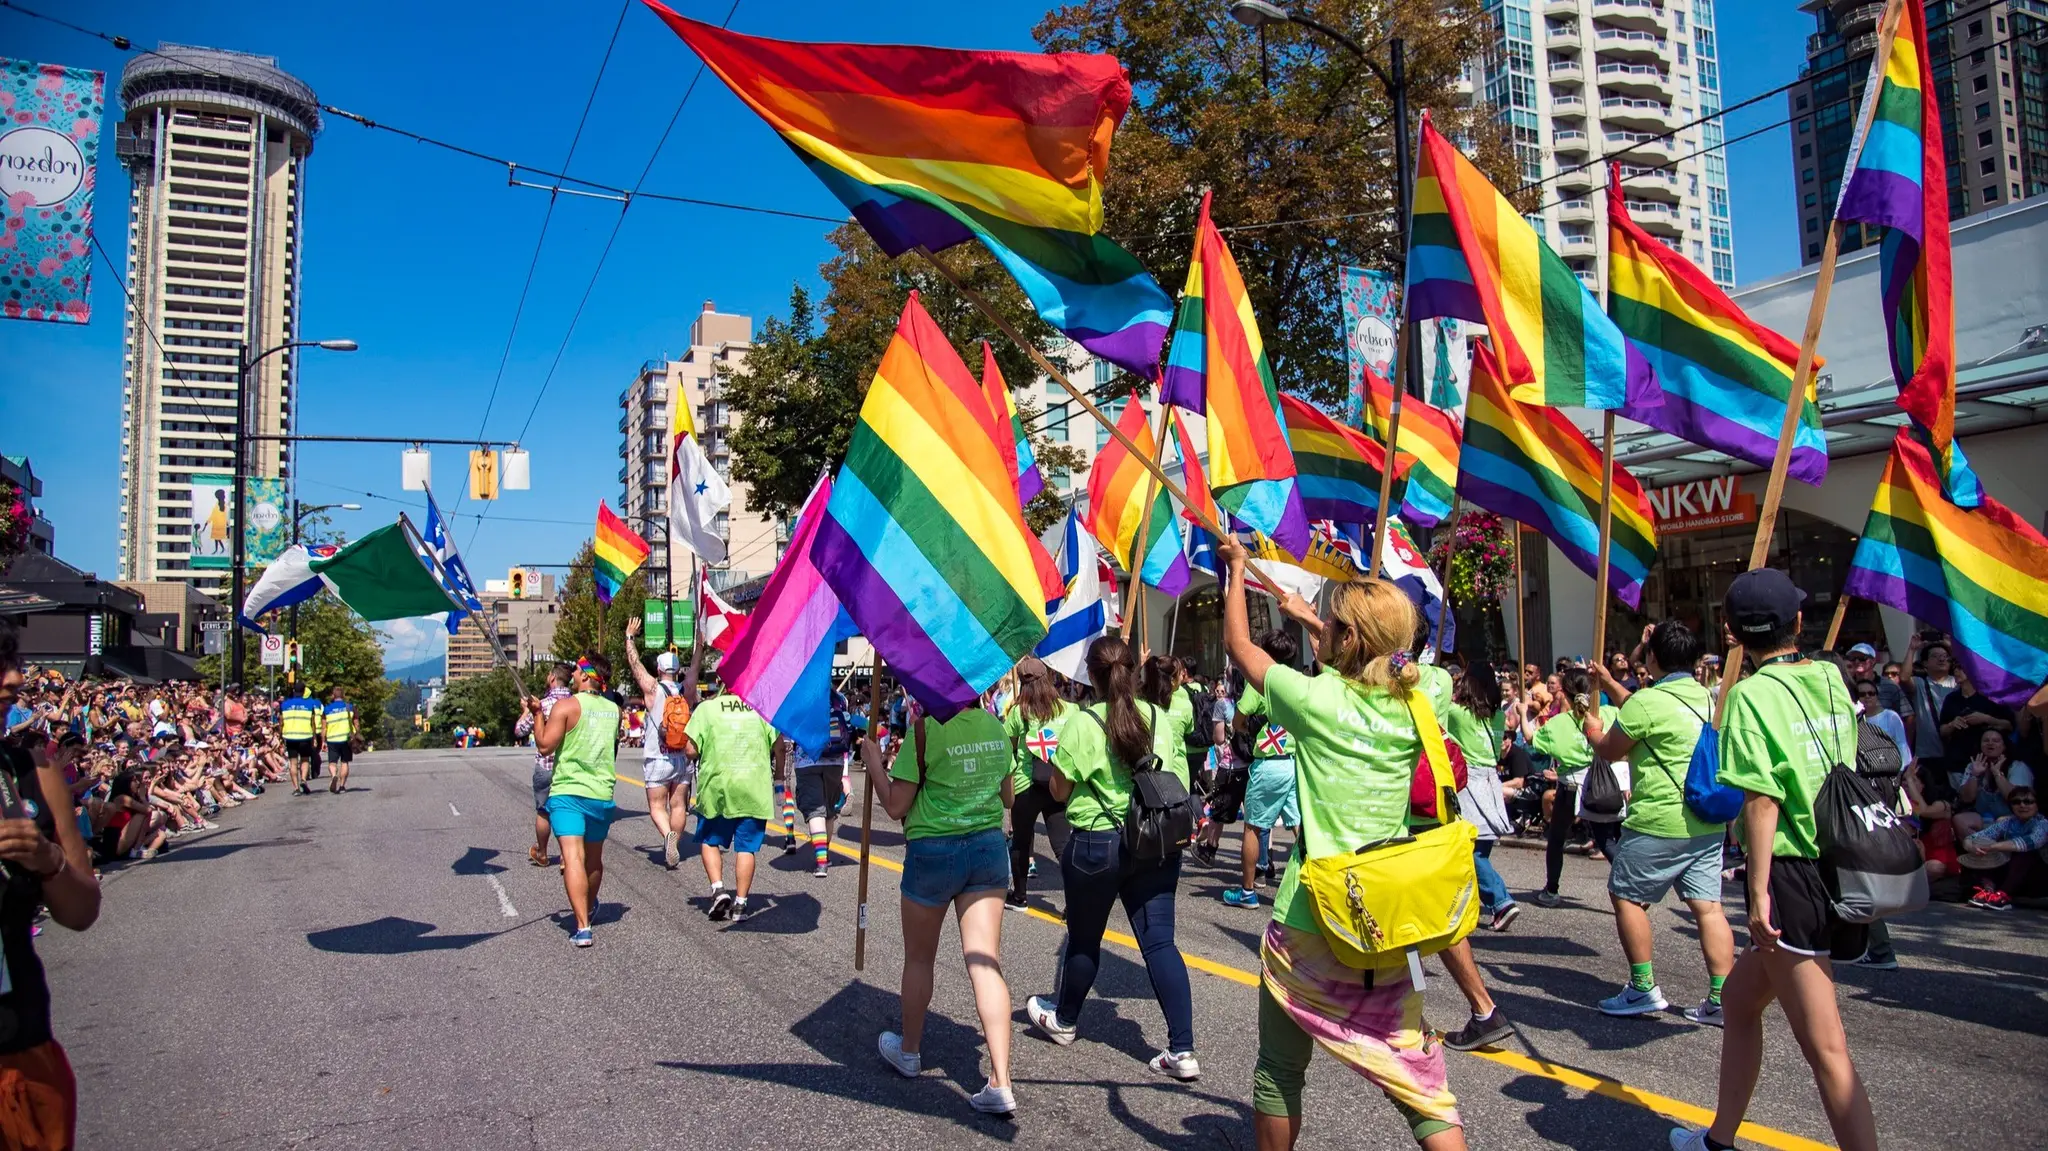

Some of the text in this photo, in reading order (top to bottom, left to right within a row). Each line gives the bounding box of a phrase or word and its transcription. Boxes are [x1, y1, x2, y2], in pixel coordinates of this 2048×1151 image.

[1359, 326, 1394, 349] robson
[1645, 475, 1735, 520] NKW
[1660, 521, 1685, 531] WORLD
[1685, 515, 1720, 528] HANDBAG
[1720, 512, 1744, 523] STORE
[90, 615, 102, 656] TIMBER
[840, 668, 874, 676] COFEE
[946, 740, 1005, 758] VOLUNTEER
